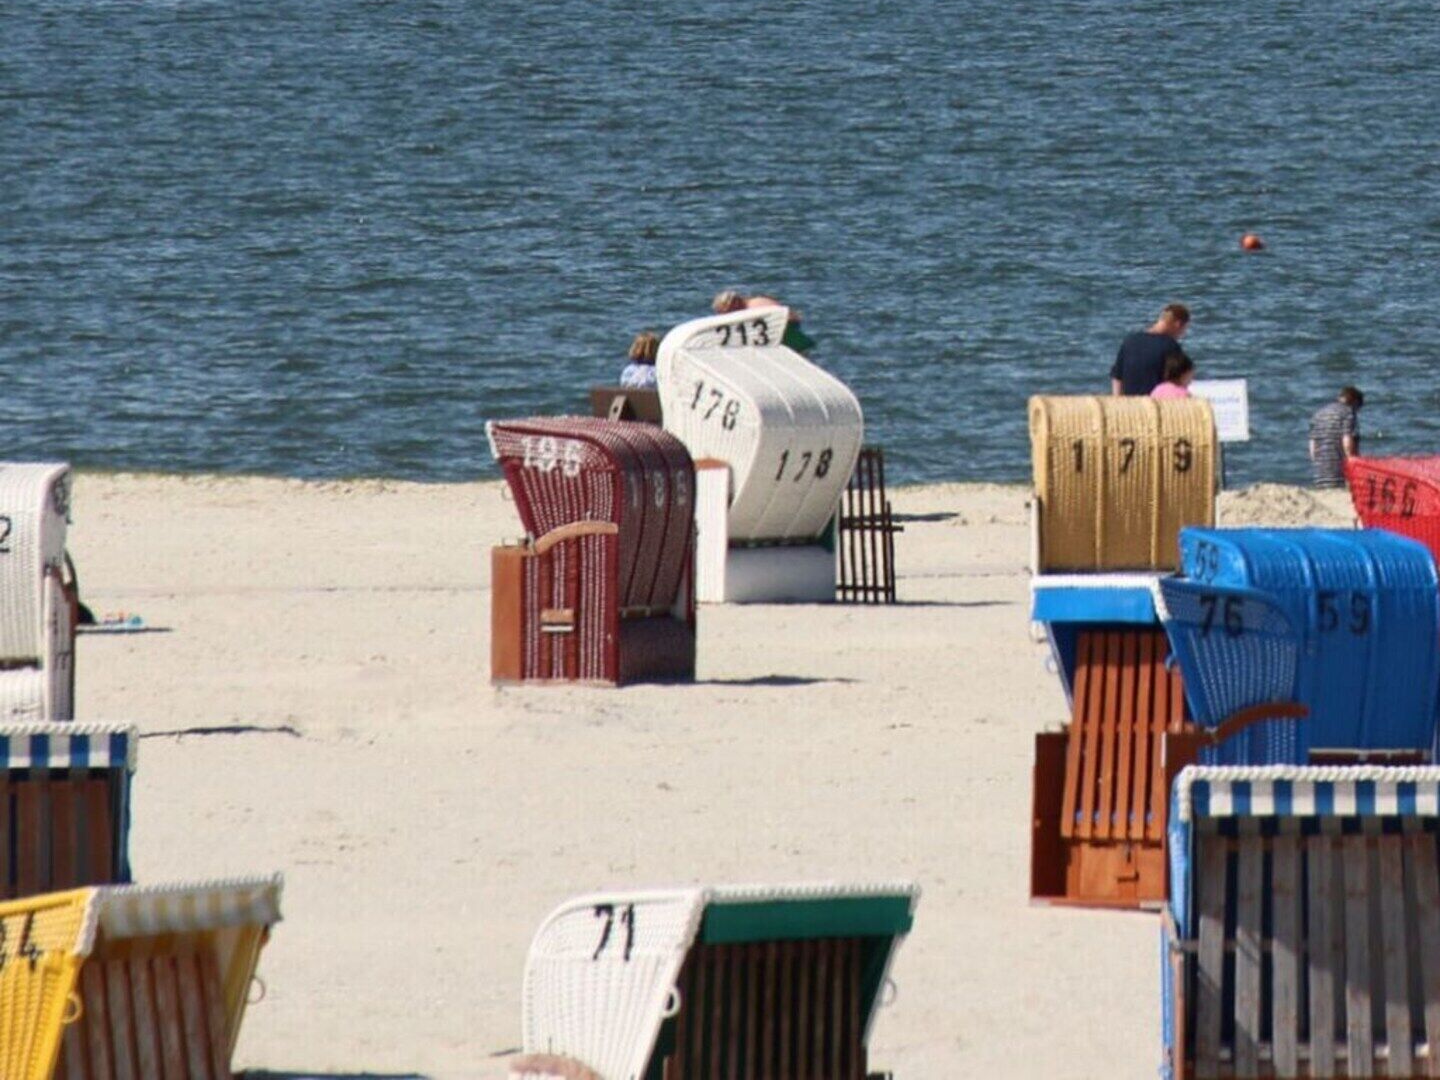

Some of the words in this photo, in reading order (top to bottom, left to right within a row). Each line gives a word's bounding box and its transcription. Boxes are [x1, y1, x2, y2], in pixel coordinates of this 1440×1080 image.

[690, 381, 742, 431] 178
[775, 447, 834, 482] 178
[1072, 436, 1193, 473] 179
[1199, 594, 1245, 639] 76
[1316, 590, 1370, 636] 59
[592, 903, 635, 962] 71
